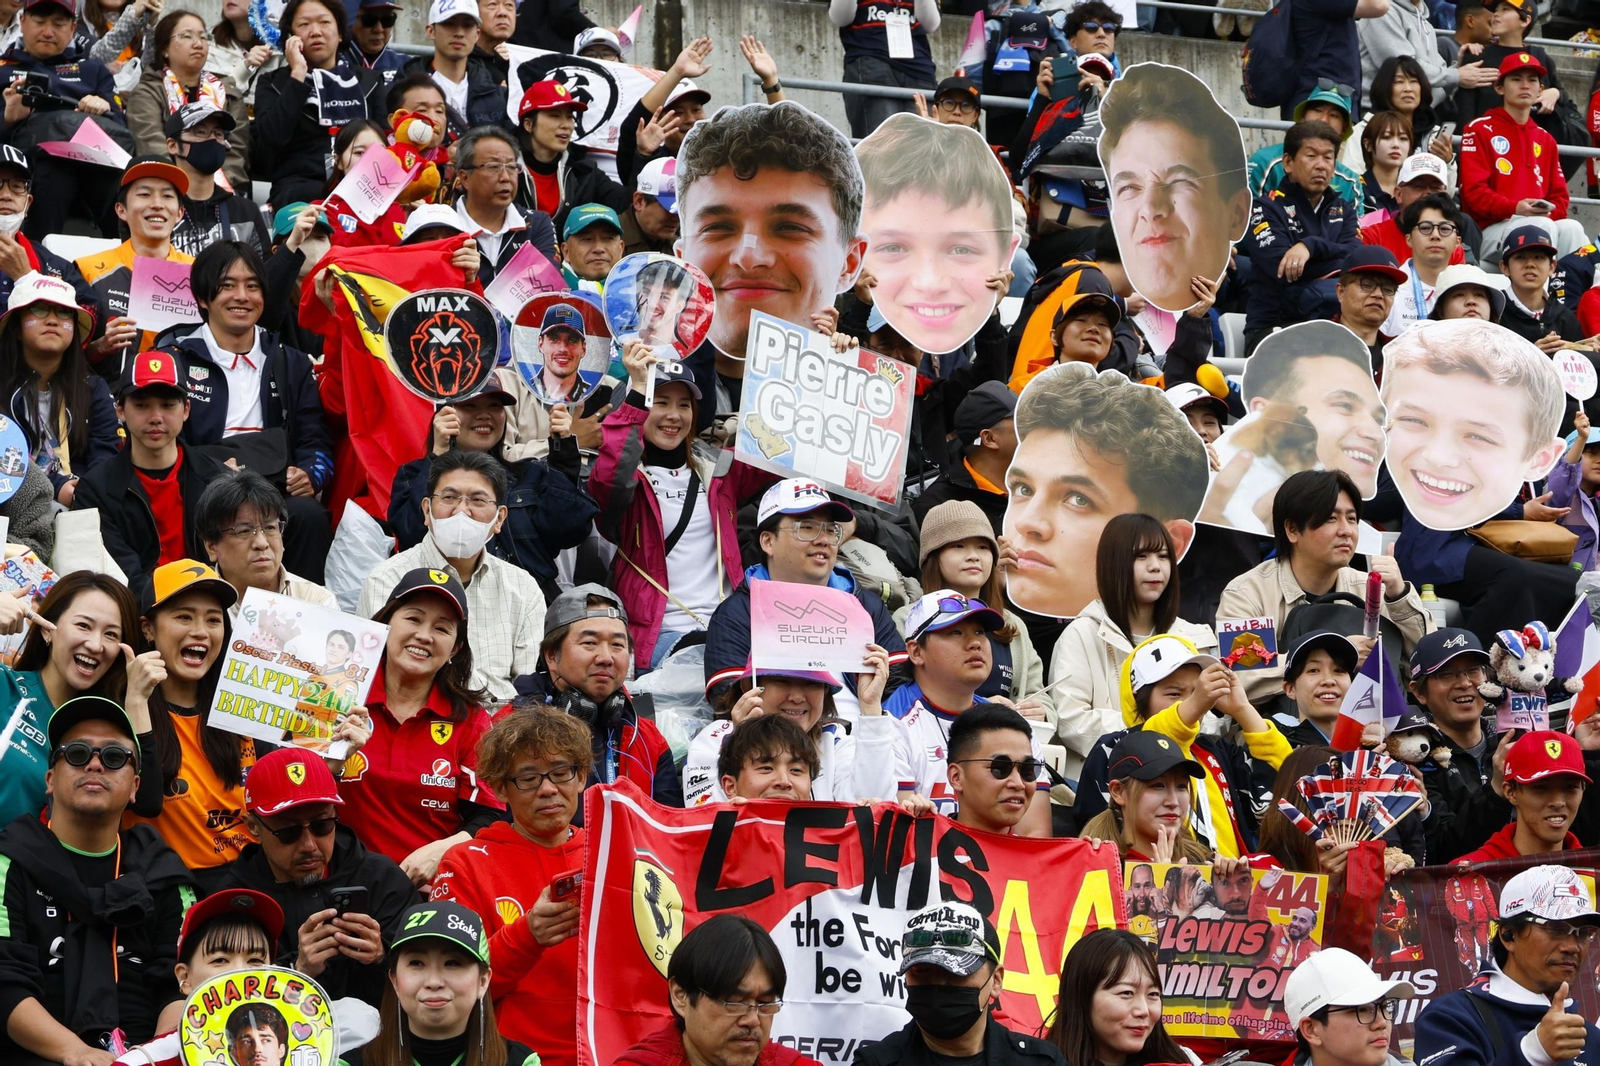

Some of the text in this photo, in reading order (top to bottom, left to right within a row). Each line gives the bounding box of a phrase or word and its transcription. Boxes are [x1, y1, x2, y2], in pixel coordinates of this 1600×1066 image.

[324, 100, 361, 108] HONDA
[1495, 140, 1508, 153] hp
[1516, 235, 1525, 245] 1
[33, 278, 68, 291] Miami
[151, 294, 200, 309] SUZUK
[151, 303, 199, 317] CIRCUI
[416, 296, 470, 312] MAX
[752, 319, 894, 418] Pierre
[1562, 361, 1587, 374] KIMI
[758, 380, 901, 481] Gasly
[777, 624, 848, 635] SUZUKA
[780, 634, 846, 646] CIRCUIT
[231, 639, 369, 682] Oscar Piastri 81
[1151, 648, 1162, 663] 1
[224, 657, 306, 700] HAPPY
[1511, 696, 1546, 712] BWT
[215, 689, 340, 742] BIRTHDAY
[1514, 714, 1530, 724] eni
[17, 720, 45, 745] JCB
[695, 805, 994, 918] LEWIS
[1266, 873, 1320, 918] 44
[404, 910, 438, 931] 27
[447, 913, 478, 942] Stake
[791, 895, 844, 948] the
[815, 950, 863, 995] be
[187, 974, 323, 1029] CHARLES
[1175, 1016, 1182, 1024] a
[1183, 1012, 1225, 1025] lifetime
[1228, 1013, 1243, 1026] of
[291, 1047, 320, 1066] 16
